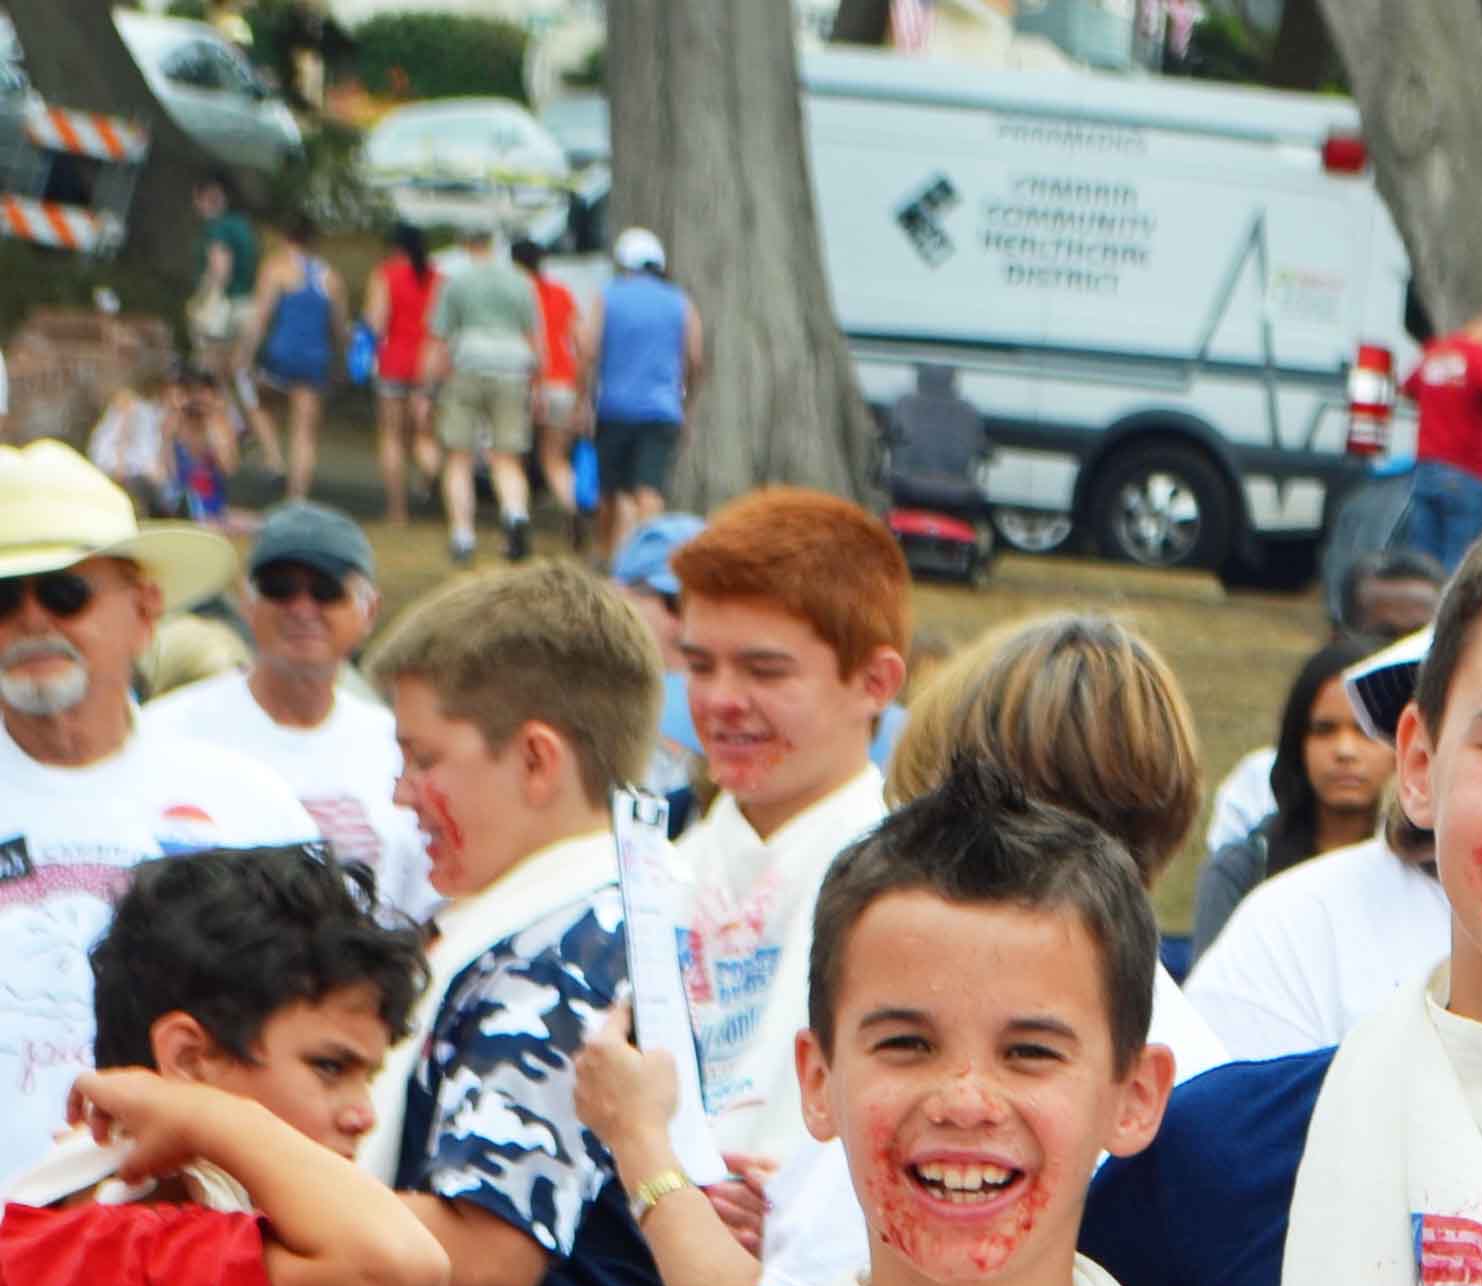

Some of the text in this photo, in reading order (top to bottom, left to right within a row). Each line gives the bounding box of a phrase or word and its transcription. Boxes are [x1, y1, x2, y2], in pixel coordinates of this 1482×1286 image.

[983, 203, 1158, 236] COMMUNITY
[981, 231, 1150, 267] HEALTHCARE
[1002, 262, 1120, 294] DISTRICT
